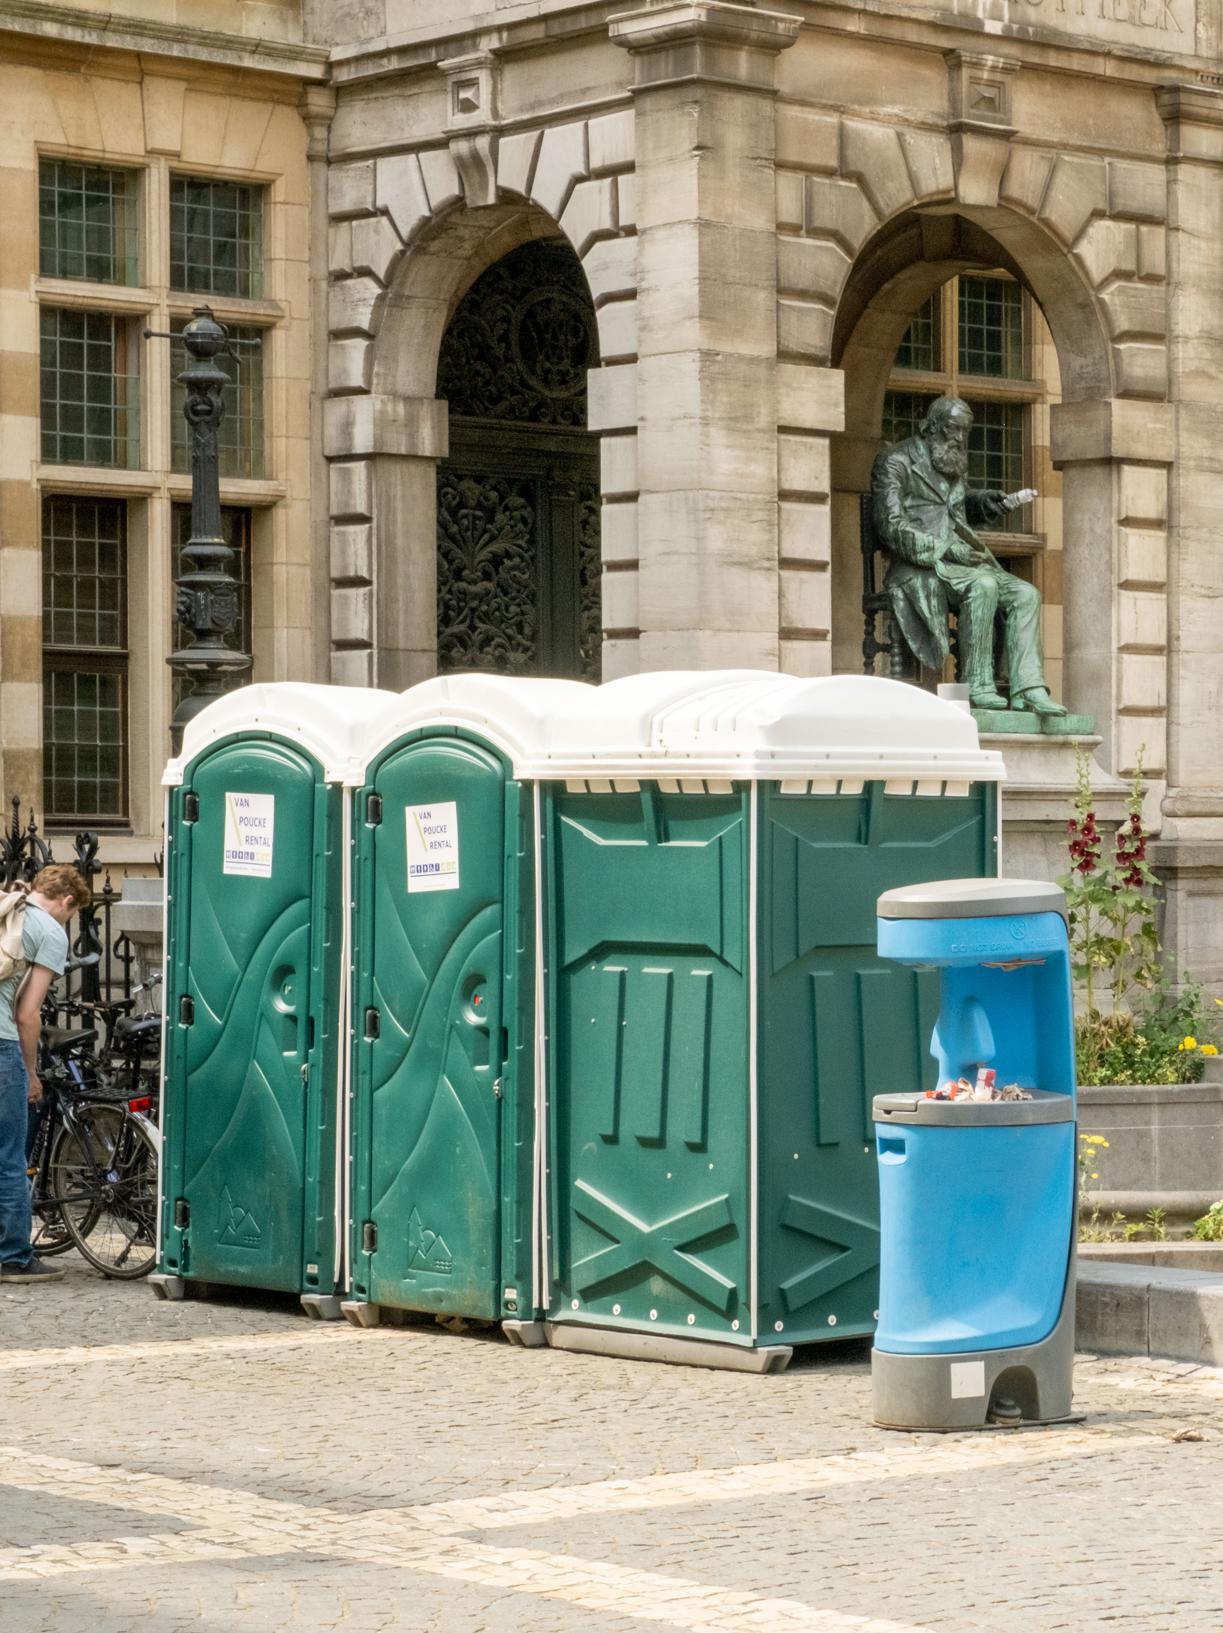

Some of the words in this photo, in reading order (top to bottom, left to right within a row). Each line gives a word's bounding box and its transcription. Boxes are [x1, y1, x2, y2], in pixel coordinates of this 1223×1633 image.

[234, 797, 250, 808] VAN
[418, 811, 432, 820] VAN
[239, 816, 267, 828] POUCKE
[423, 825, 448, 835] POUCKE
[245, 835, 271, 847] RENTAL
[429, 840, 452, 849] RENTAL
